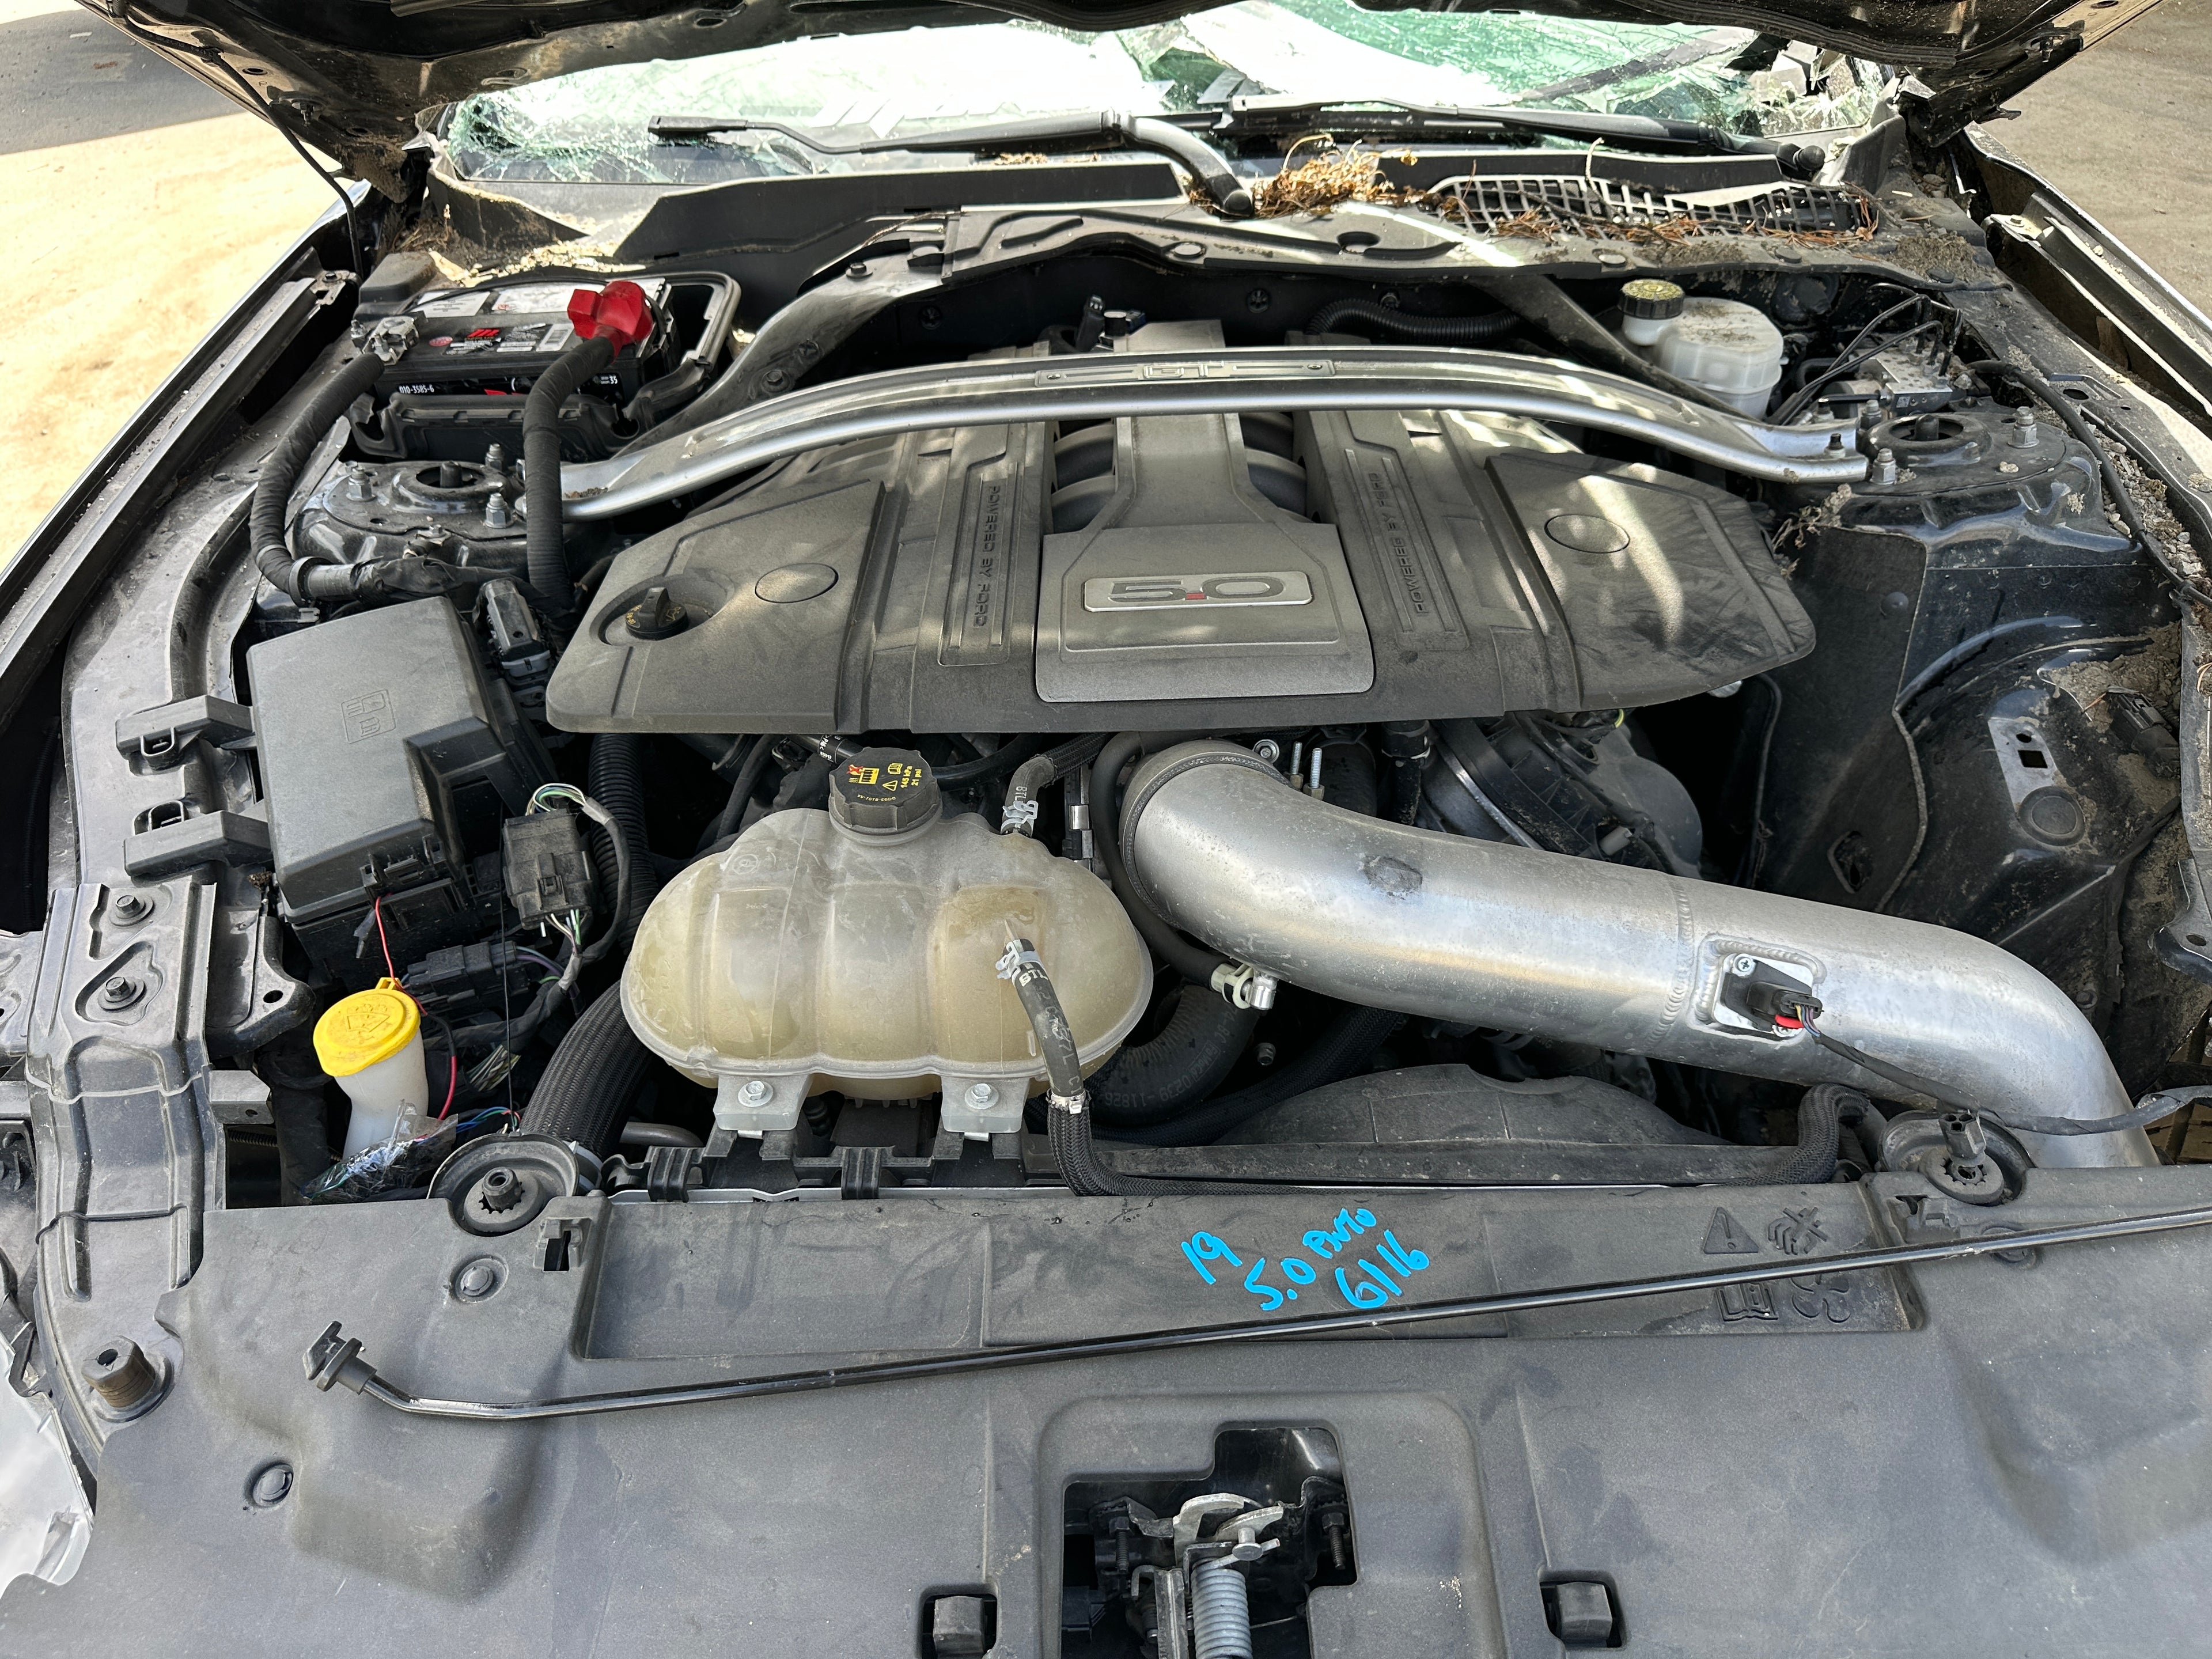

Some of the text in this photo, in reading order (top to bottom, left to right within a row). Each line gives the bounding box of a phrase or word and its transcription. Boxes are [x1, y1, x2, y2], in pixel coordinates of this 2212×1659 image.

[1143, 361, 1225, 378] GT
[973, 485, 1001, 627] POWERED BY FORD
[1369, 472, 1429, 614] POWERED BY FORD
[1107, 575, 1287, 603] 5.0
[904, 766, 913, 777] kPa
[911, 768, 923, 787] 21 psi
[1181, 1230, 1243, 1285] 19
[1244, 1257, 1316, 1311] 5.0
